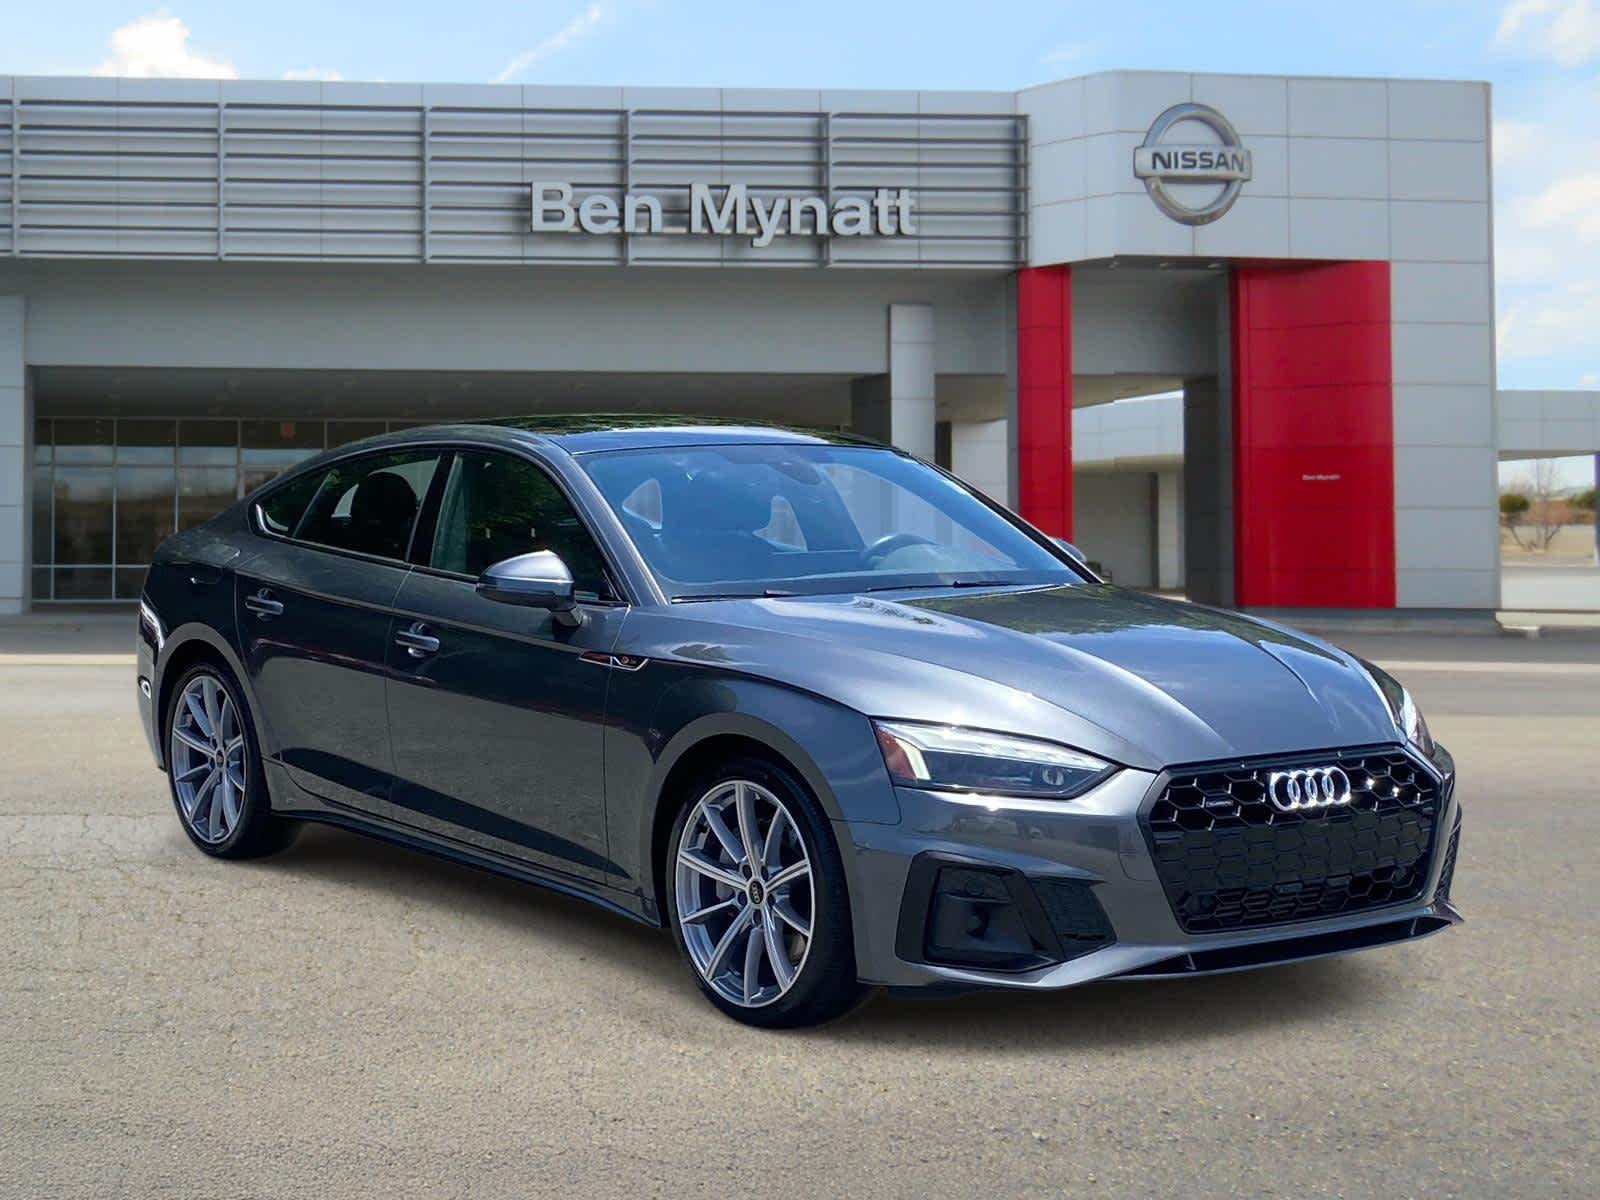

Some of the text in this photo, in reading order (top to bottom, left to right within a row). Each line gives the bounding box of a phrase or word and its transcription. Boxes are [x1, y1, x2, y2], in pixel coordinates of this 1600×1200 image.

[1151, 151, 1244, 172] NISSAN
[531, 180, 917, 248] Ben Mynatt
